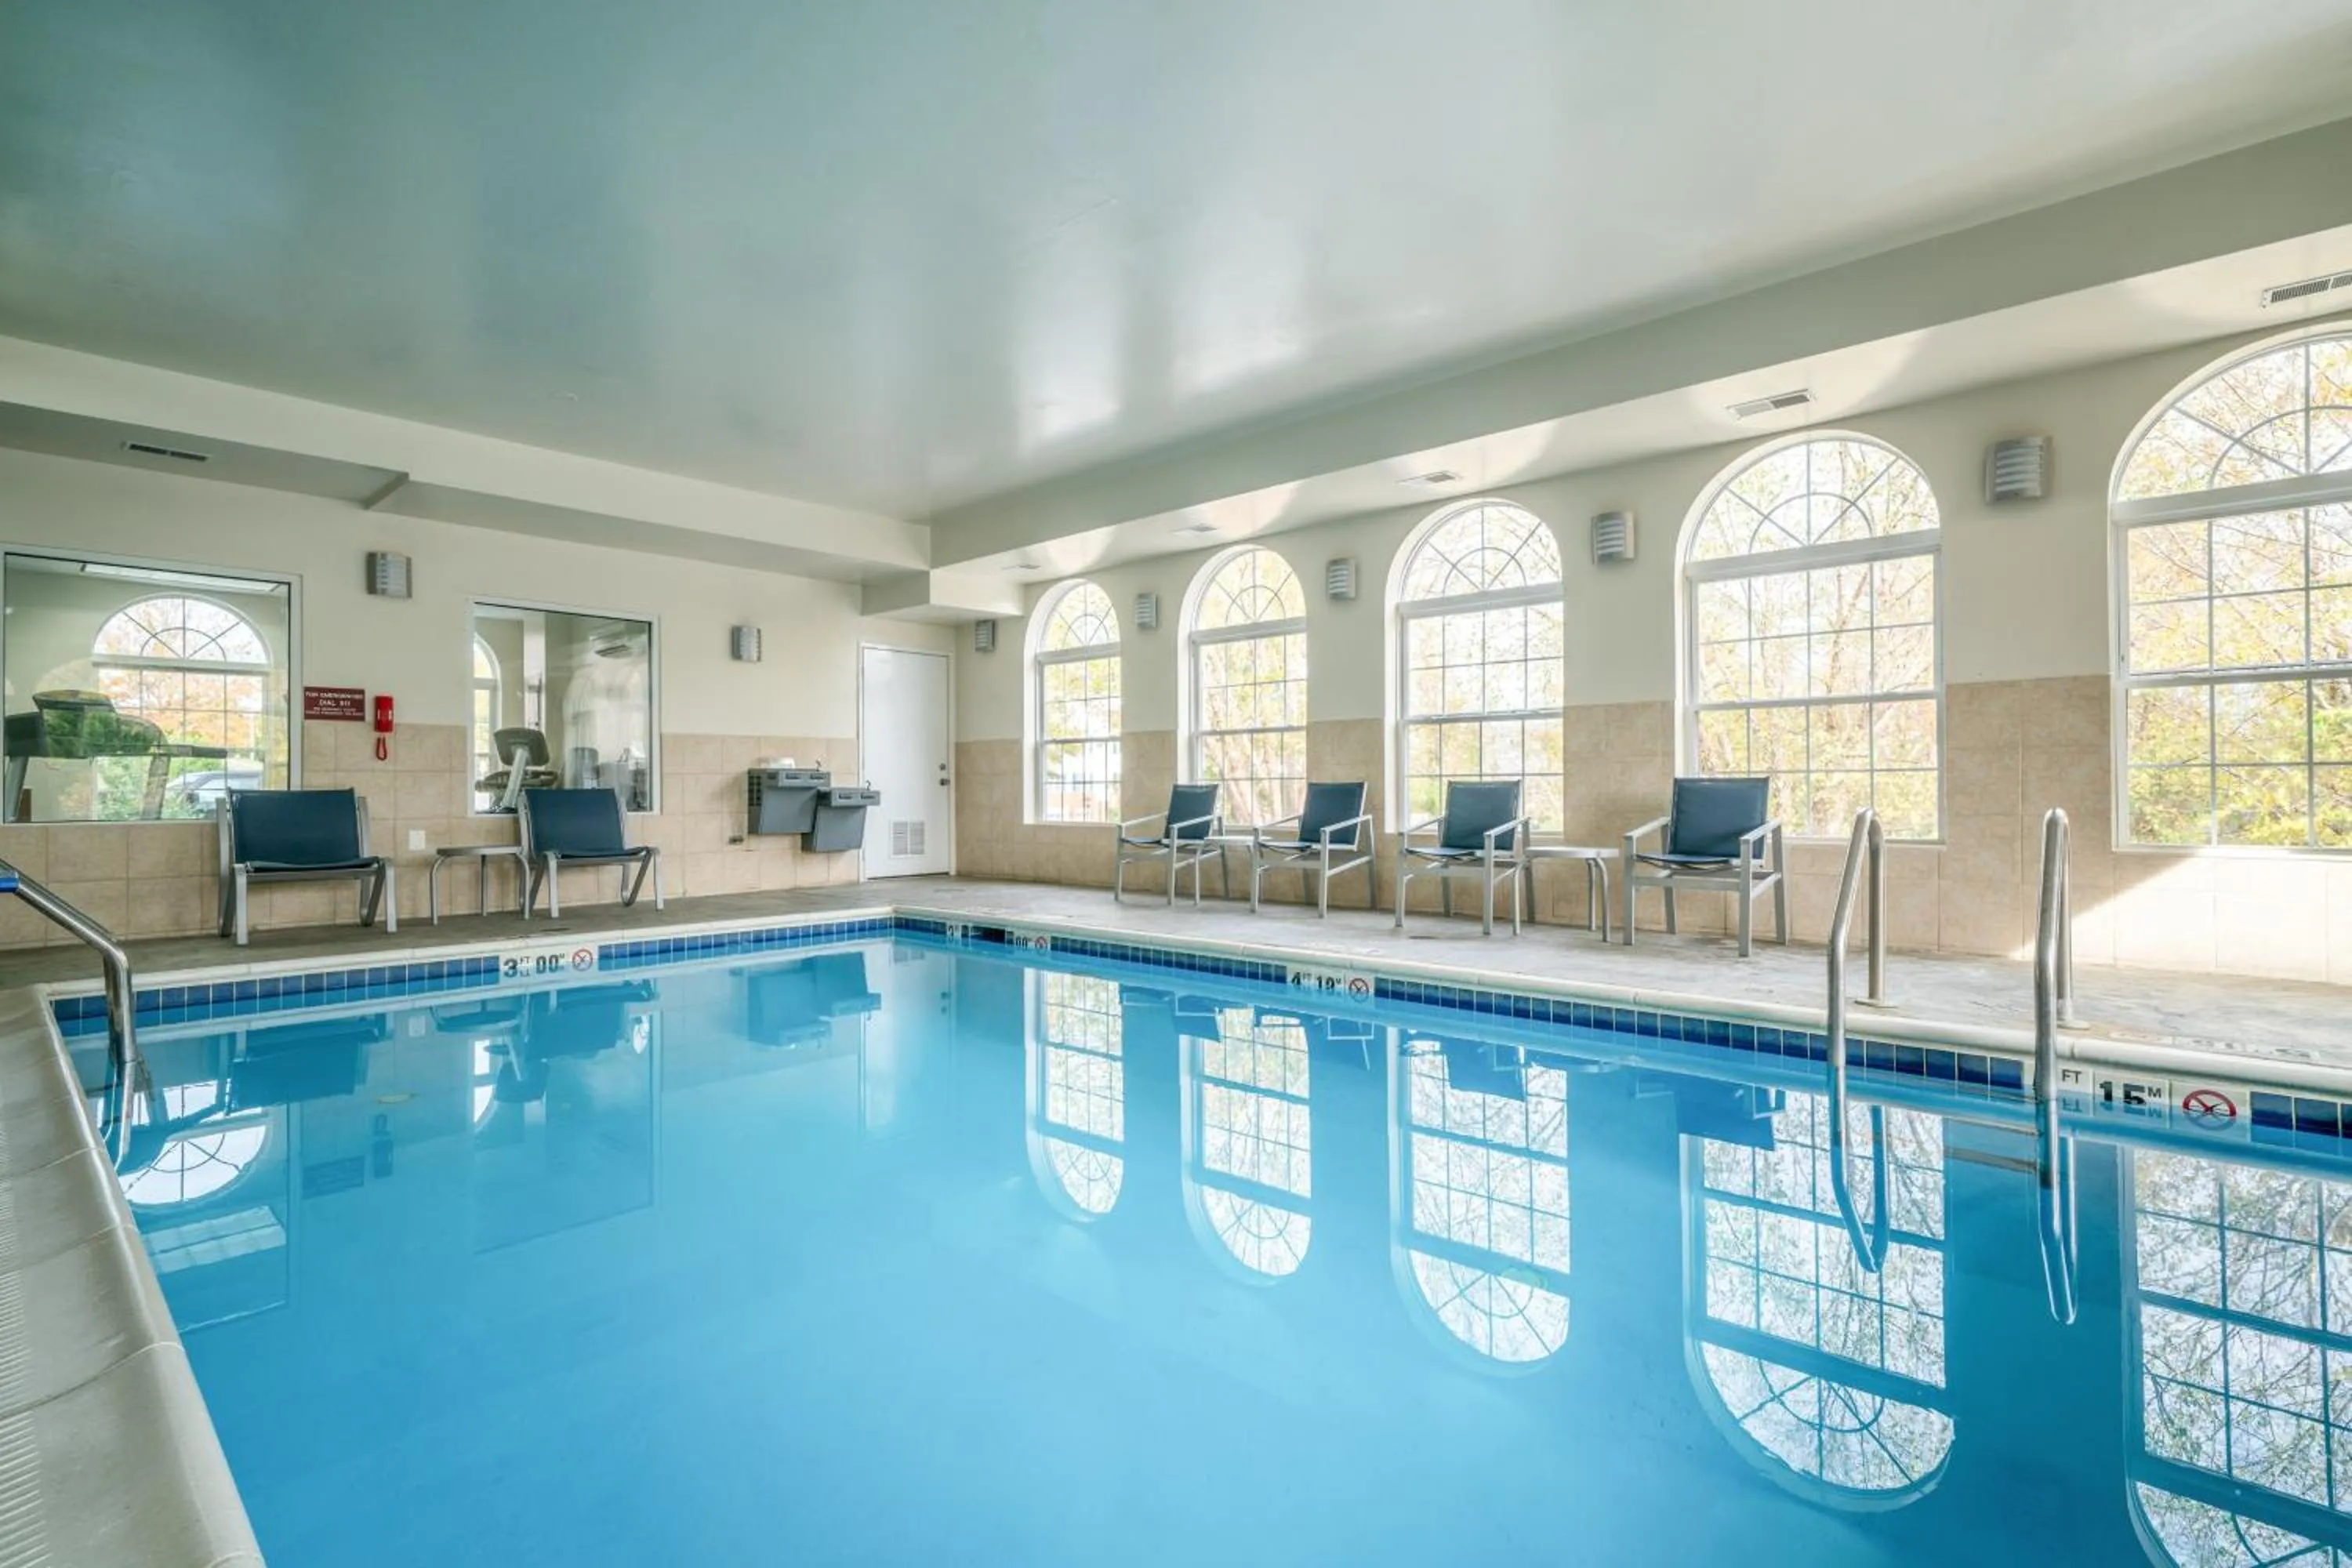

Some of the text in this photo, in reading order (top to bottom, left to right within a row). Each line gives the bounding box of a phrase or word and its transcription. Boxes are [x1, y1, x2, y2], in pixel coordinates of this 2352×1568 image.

[2062, 1069, 2161, 1105] FT 15 M
